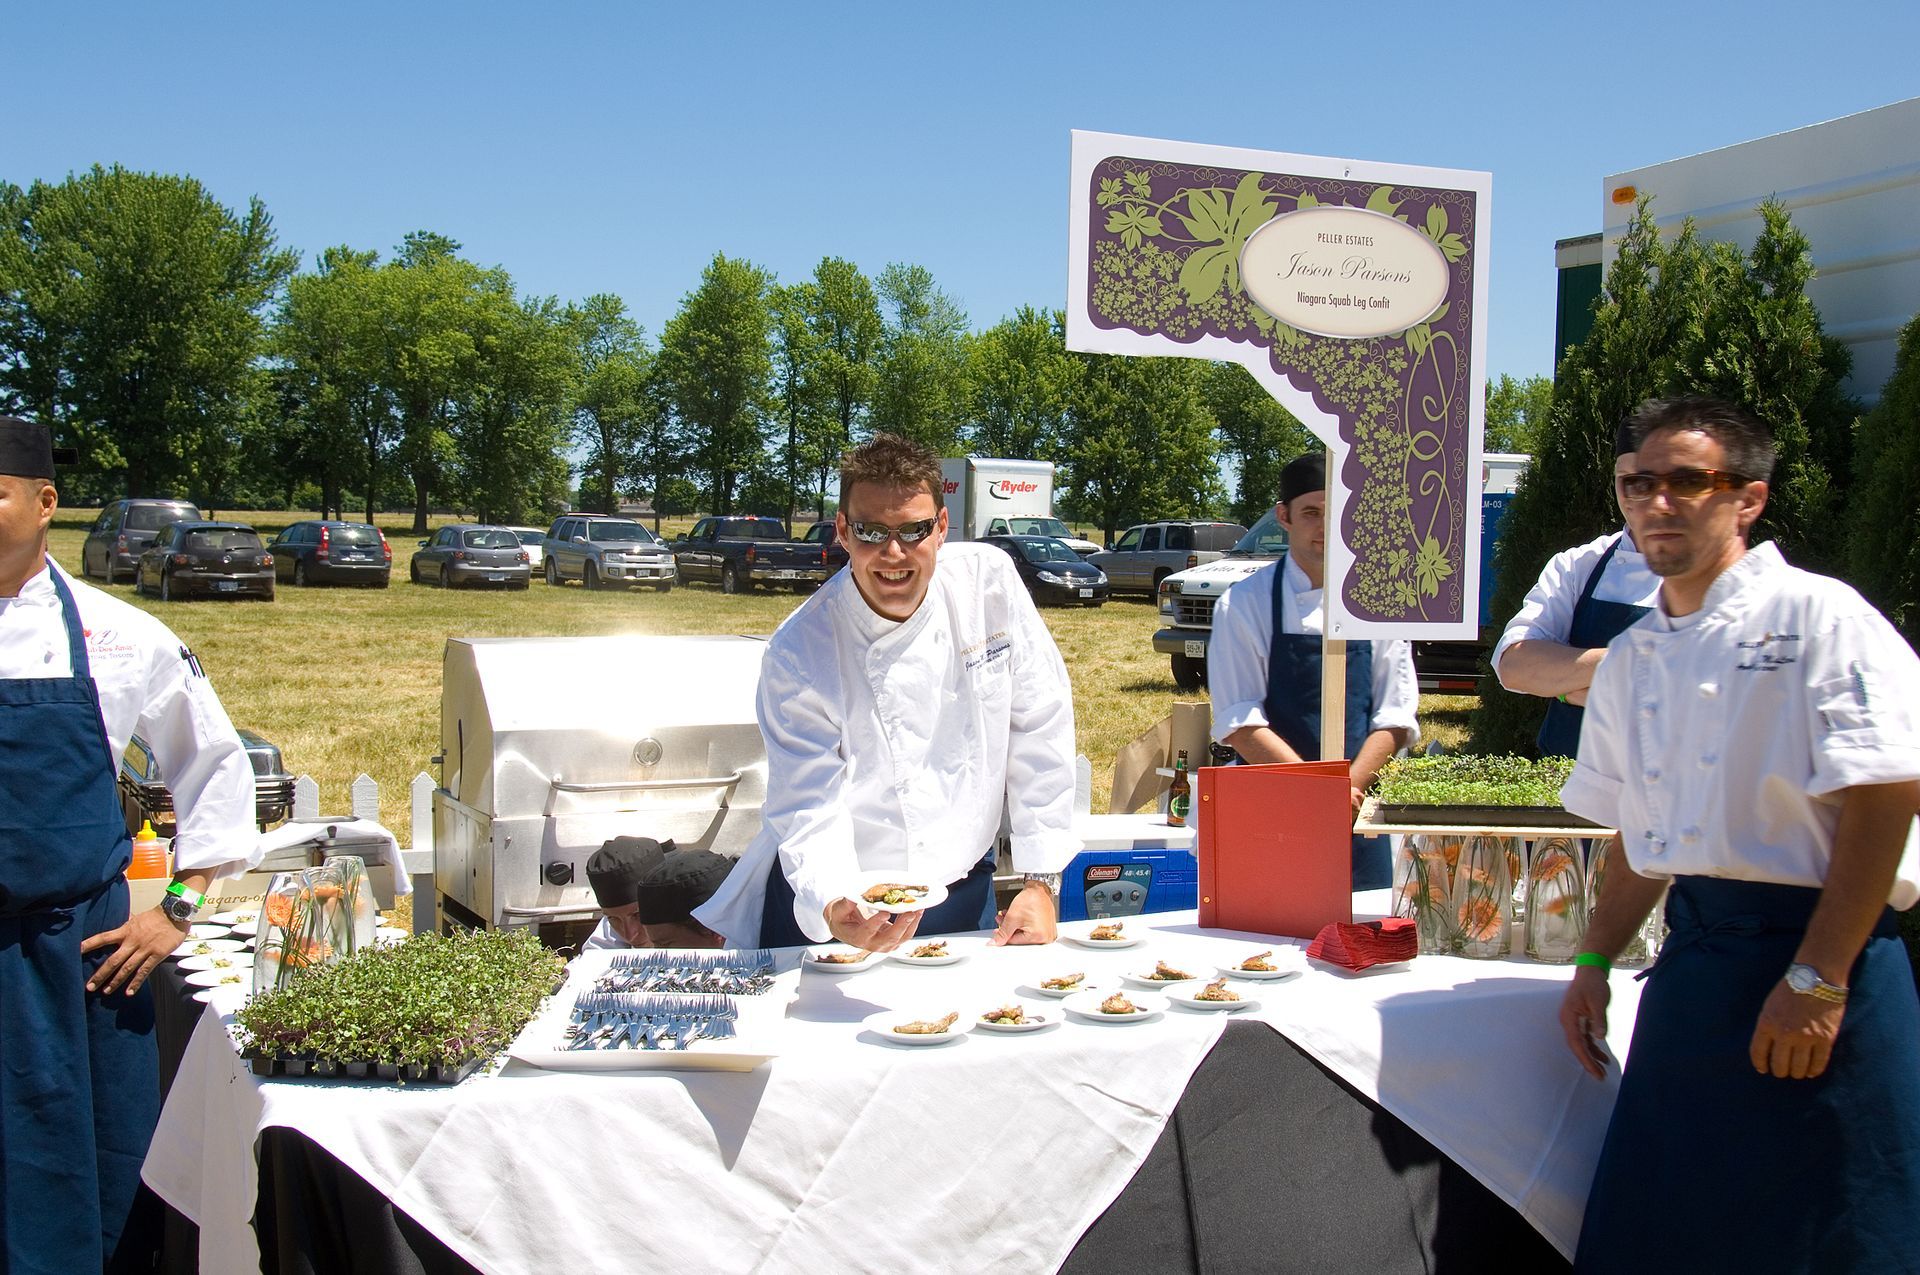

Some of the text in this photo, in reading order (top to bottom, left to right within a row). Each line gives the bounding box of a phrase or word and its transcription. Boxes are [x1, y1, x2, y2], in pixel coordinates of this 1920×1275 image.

[1317, 233, 1374, 246] PELLER ESTATES
[1277, 250, 1412, 284] Jason Parsons
[1297, 291, 1390, 310] Niagara Squab Leg Confit
[942, 478, 960, 494] der
[1000, 480, 1038, 494] Ryder
[1090, 868, 1114, 877] Coleman
[203, 894, 266, 908] iagara-o
